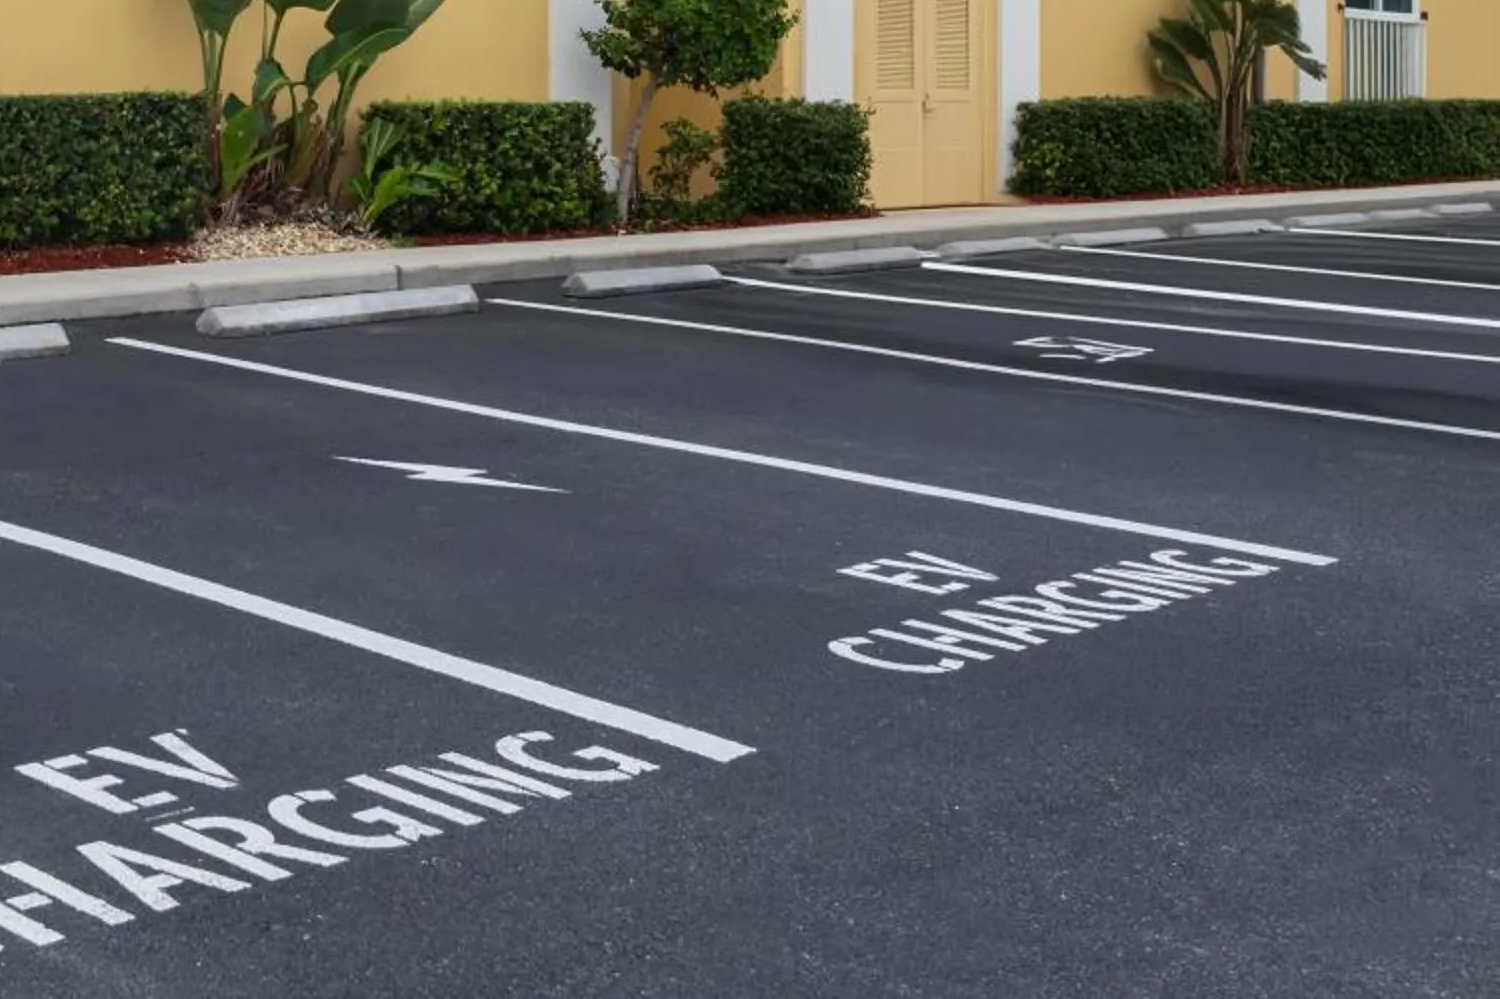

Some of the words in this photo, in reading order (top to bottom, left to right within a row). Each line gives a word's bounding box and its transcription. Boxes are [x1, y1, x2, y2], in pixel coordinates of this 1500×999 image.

[828, 549, 1280, 674] CHARGING
[836, 550, 999, 596] EV
[13, 728, 240, 815] EV
